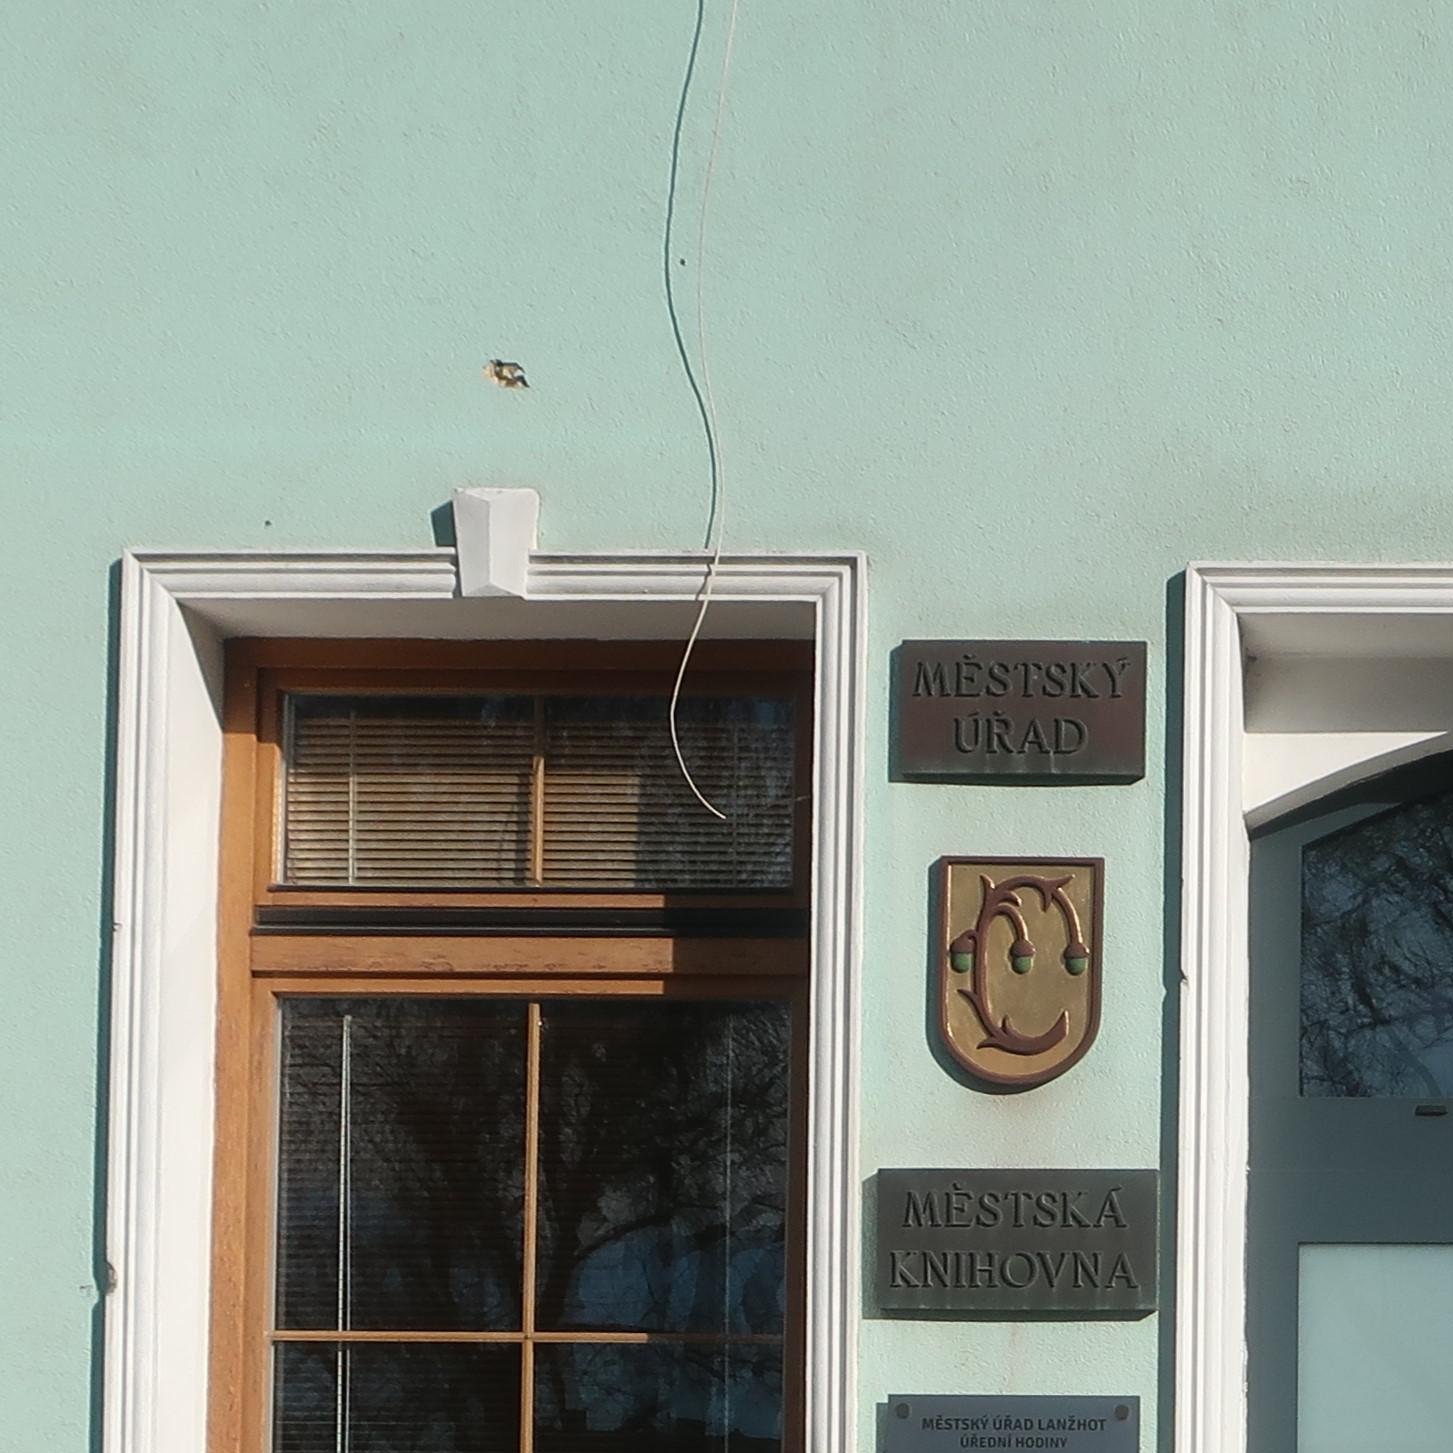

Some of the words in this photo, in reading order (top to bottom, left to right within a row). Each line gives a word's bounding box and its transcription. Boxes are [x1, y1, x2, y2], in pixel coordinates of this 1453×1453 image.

[911, 653, 1132, 699] MĚSTSKÝ
[953, 709, 1089, 755] ÚŘAD
[901, 1182, 1129, 1229] MĚSTSKÁ
[889, 1250, 1140, 1289] KNIHOVNA
[921, 1414, 989, 1431] MĚSTSKÝ
[993, 1415, 1034, 1431] ÚŘAD
[1038, 1415, 1107, 1432] LANŽHOT
[960, 1433, 1012, 1448] ÚŘEDNÍ
[1015, 1436, 1068, 1449] HODINY
